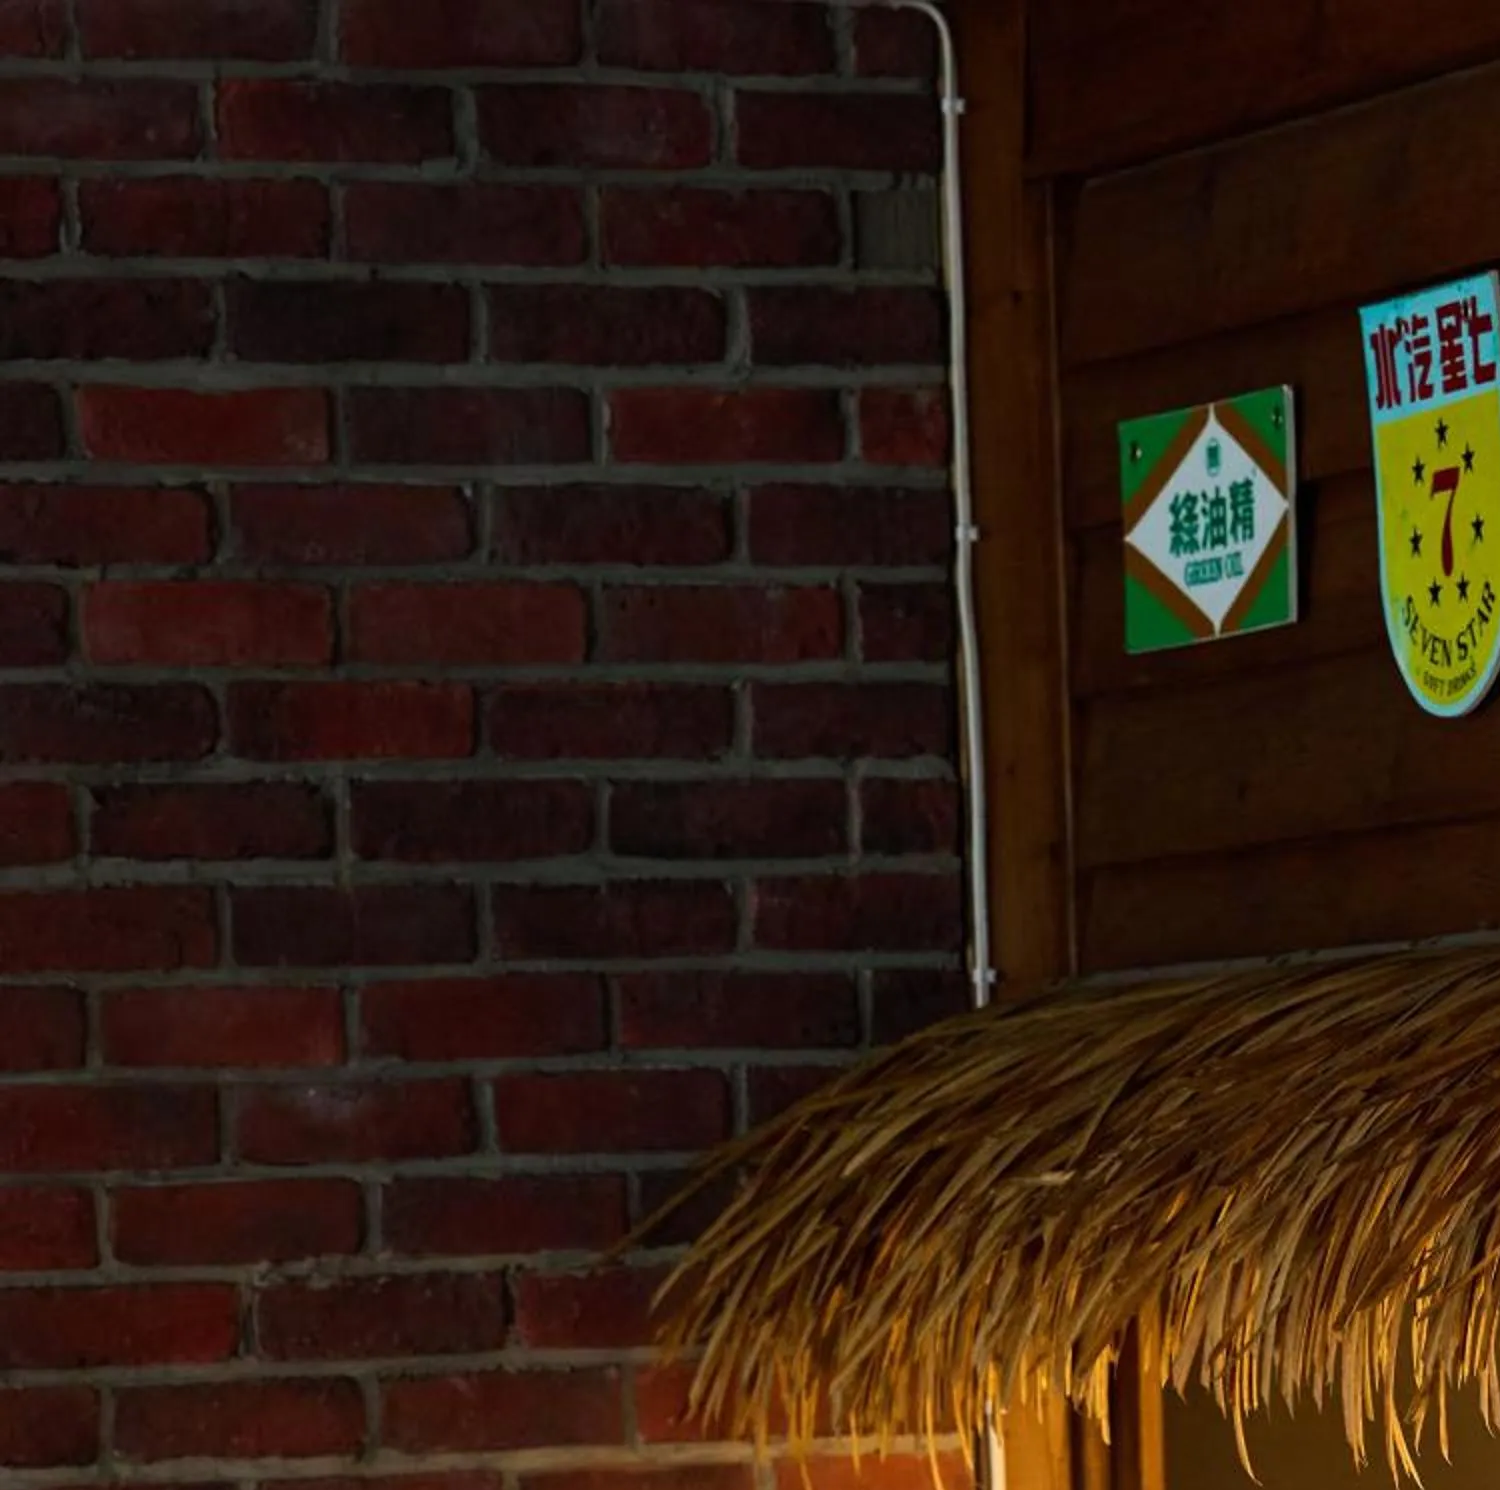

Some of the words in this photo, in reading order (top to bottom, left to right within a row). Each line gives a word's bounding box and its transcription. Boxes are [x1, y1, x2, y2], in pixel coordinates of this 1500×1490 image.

[1430, 467, 1460, 577] 7
[1402, 595, 1452, 667] SEVEN
[1455, 581, 1496, 662] STAR
